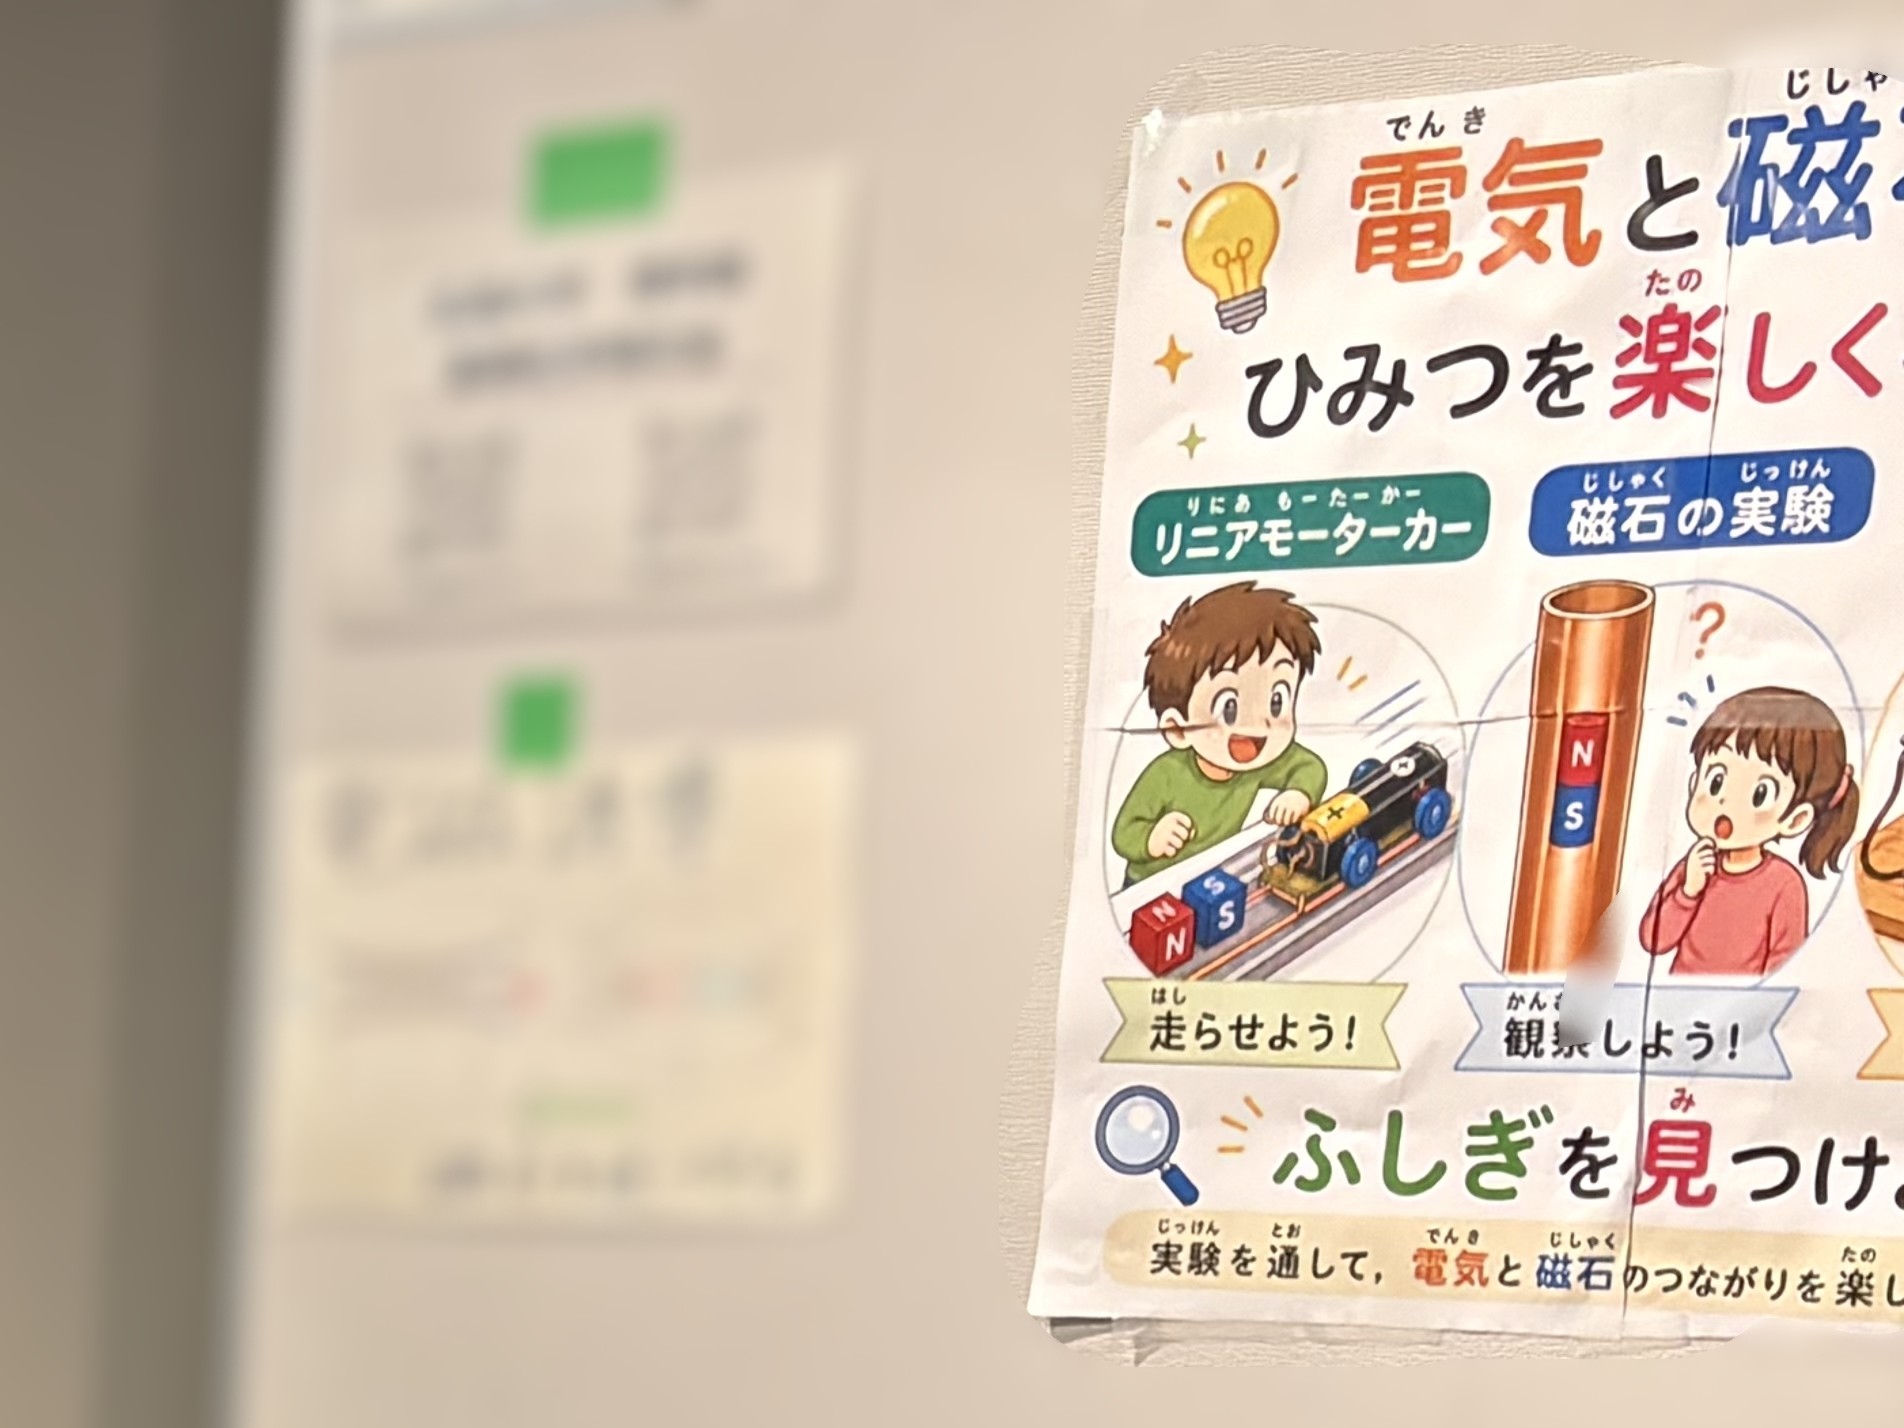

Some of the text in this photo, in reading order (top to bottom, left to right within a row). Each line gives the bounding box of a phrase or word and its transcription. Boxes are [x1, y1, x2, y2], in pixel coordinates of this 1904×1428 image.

[1386, 105, 1487, 141] でんき
[1350, 100, 1904, 284] 電気と磁
[1644, 267, 1703, 297] たの
[1245, 302, 1904, 439] ひみつを楽しく
[1583, 458, 1832, 494] じしゃく じっけん
[1566, 483, 1836, 546] 磁石の実験
[1155, 507, 1472, 566] リニアモーターカー
[1571, 738, 1595, 768] N
[1563, 801, 1584, 831] S
[1218, 900, 1235, 931] S
[1165, 926, 1186, 961] N
[1150, 987, 1187, 1006] はし
[1149, 1009, 1356, 1052] 走らせよう！
[1669, 1087, 1697, 1112] み
[1272, 1104, 1904, 1211] ふしぎを見つけ
[1157, 1218, 1877, 1263] じっけん とお でんき じしゃく たの
